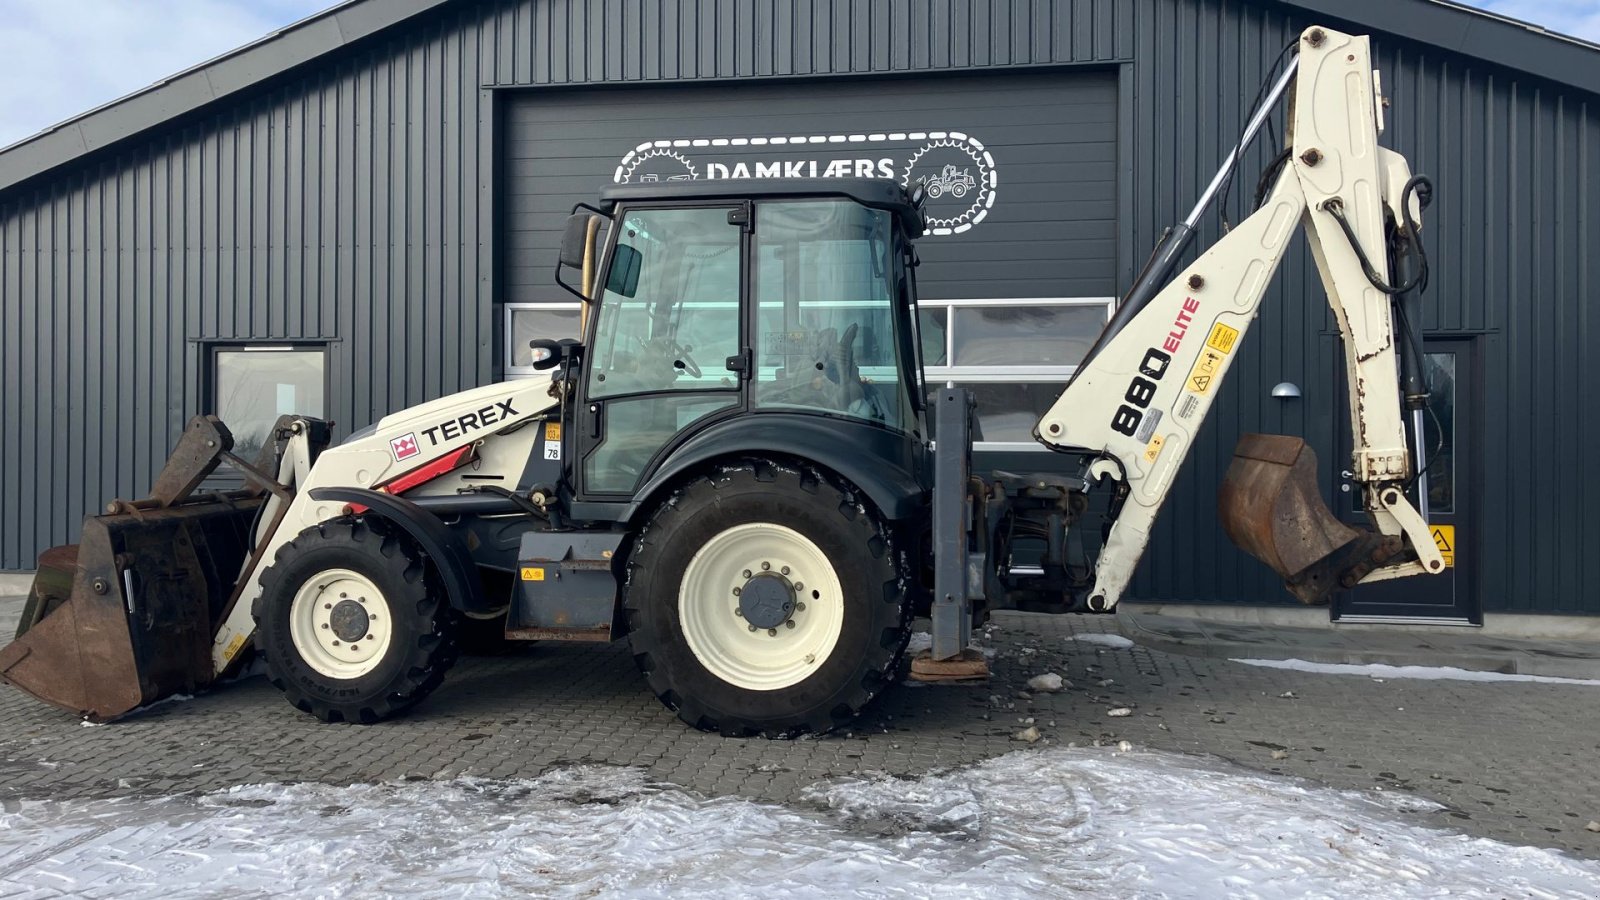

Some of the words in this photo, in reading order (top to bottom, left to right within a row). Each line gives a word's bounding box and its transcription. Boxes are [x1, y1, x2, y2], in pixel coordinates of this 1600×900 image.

[1162, 296, 1200, 354] ELITE
[1110, 347, 1172, 437] 880
[421, 397, 519, 446] TEREX
[547, 449, 558, 459] 78
